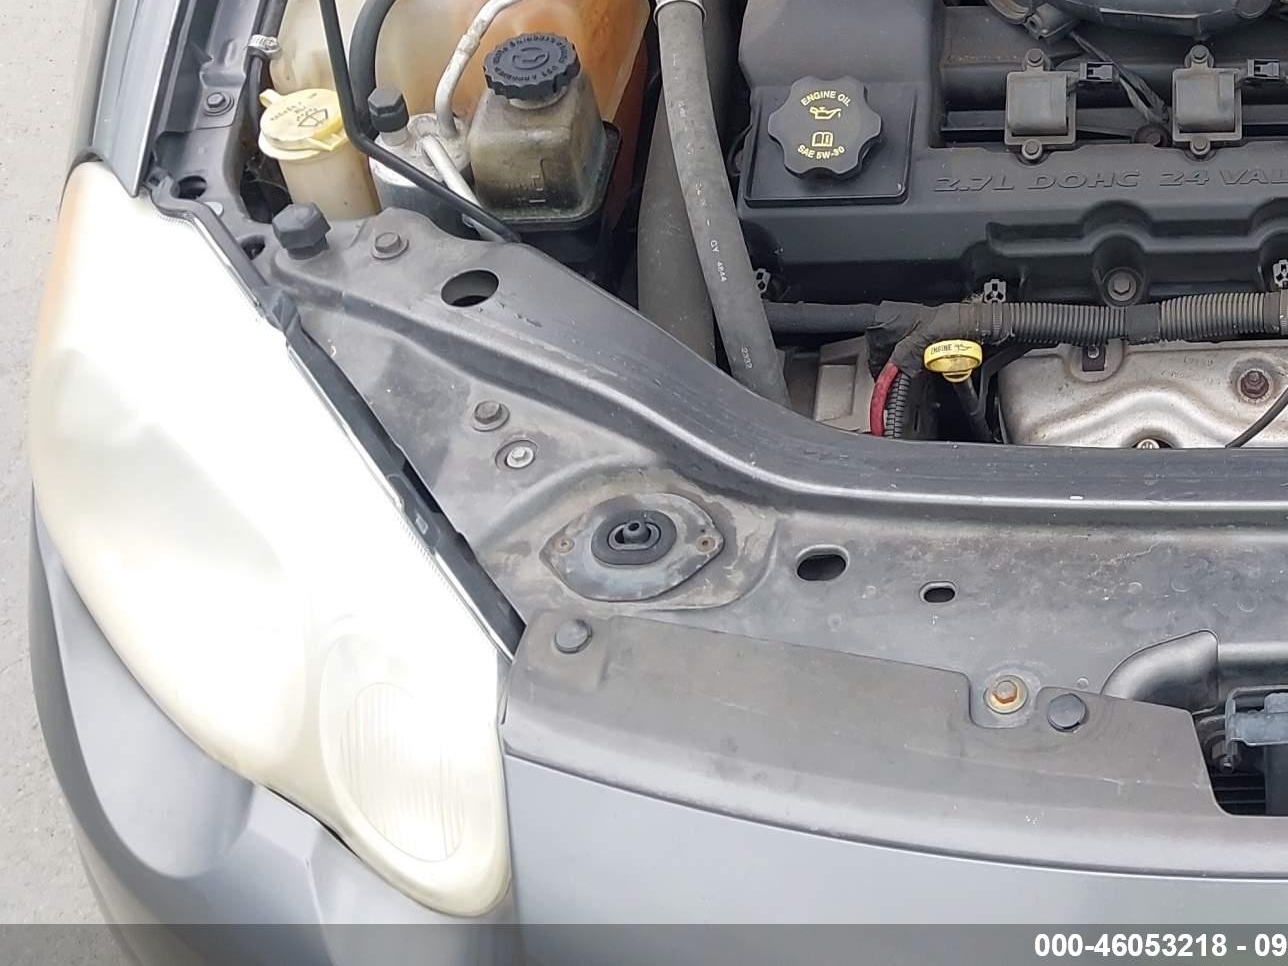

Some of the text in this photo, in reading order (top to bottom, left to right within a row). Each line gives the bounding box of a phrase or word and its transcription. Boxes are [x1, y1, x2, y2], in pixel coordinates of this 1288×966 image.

[800, 90, 851, 107] ENGINE OIL
[798, 144, 815, 158] SAE
[933, 177, 1015, 192] 2.7L
[1027, 172, 1143, 189] DOHC
[1159, 171, 1210, 187] 24
